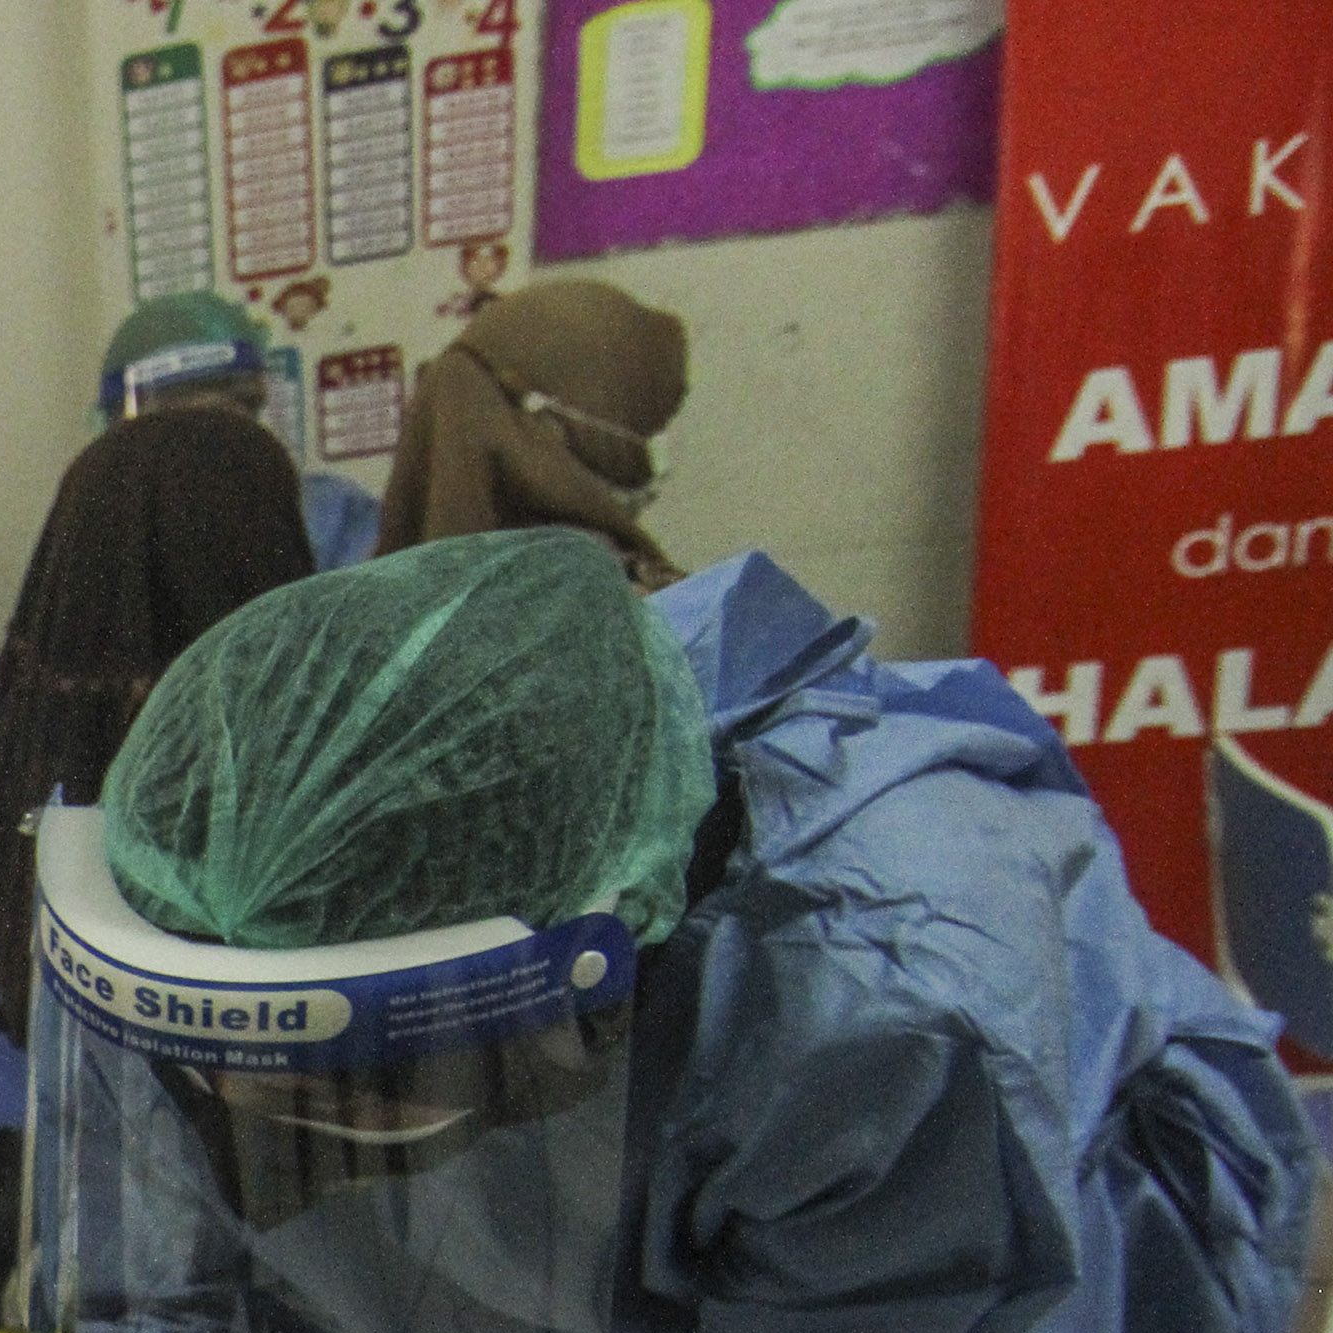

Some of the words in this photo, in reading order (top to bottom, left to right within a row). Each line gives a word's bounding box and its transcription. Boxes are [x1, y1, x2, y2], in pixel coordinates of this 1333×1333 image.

[1171, 512, 1333, 578] dan
[47, 926, 115, 1001] Face
[133, 986, 309, 1033] Shield
